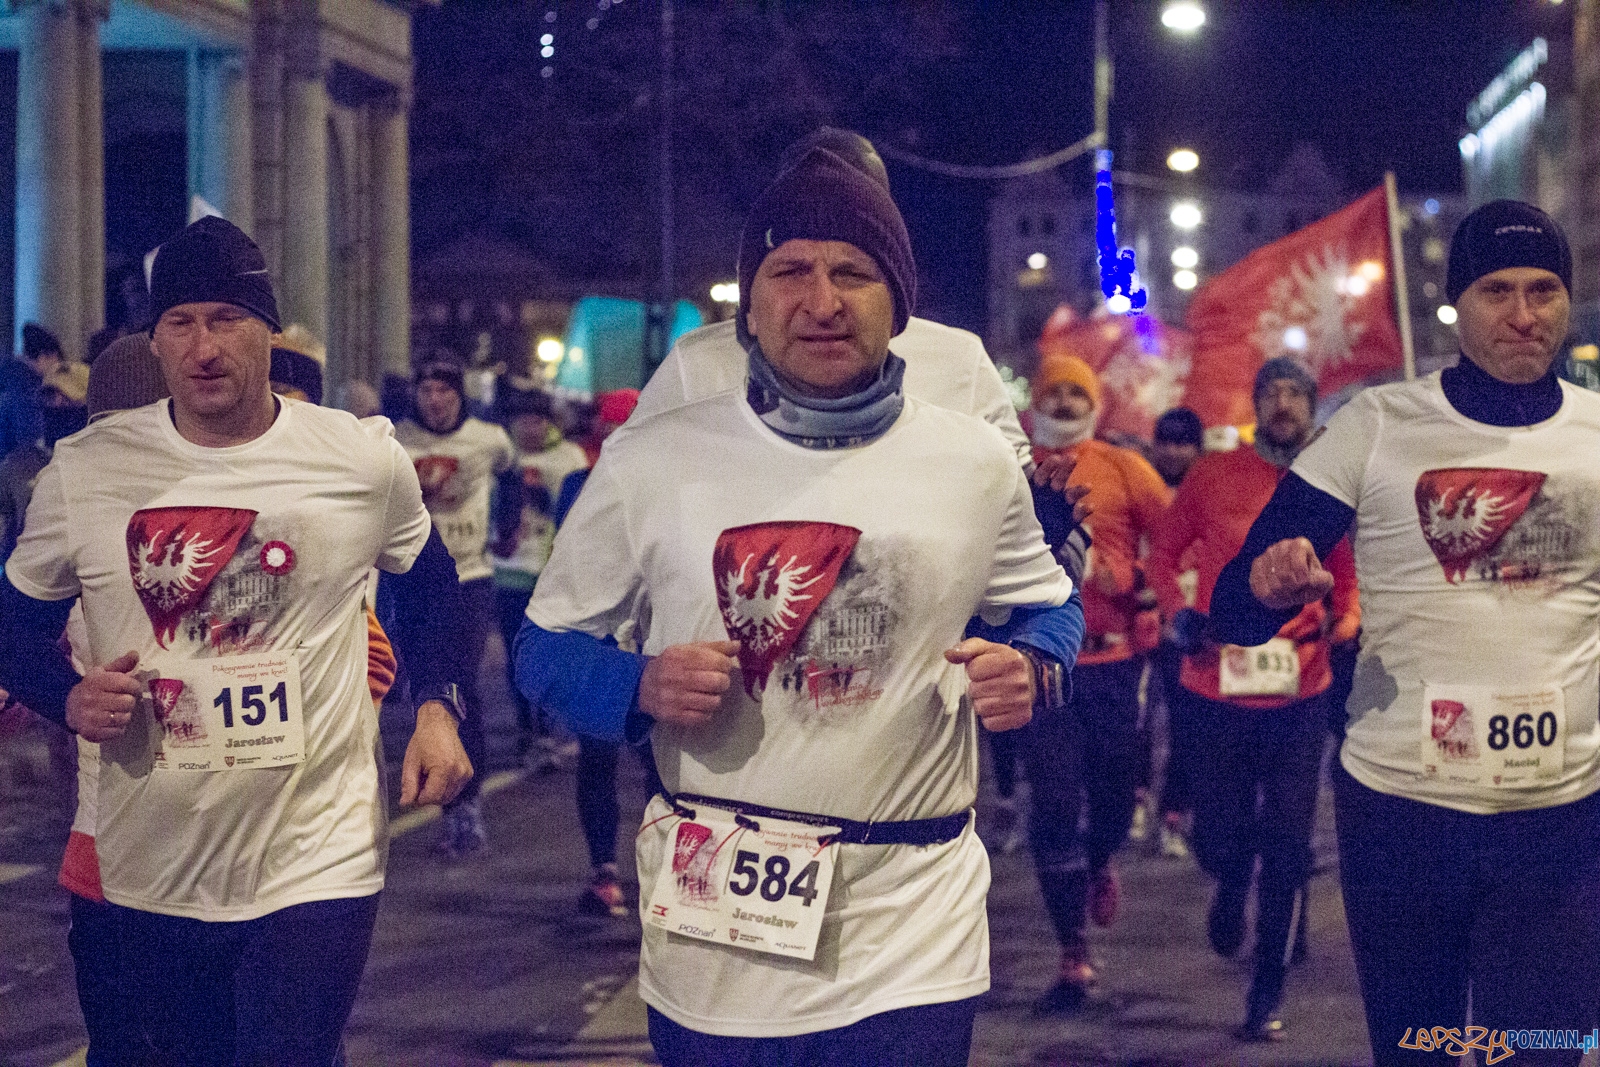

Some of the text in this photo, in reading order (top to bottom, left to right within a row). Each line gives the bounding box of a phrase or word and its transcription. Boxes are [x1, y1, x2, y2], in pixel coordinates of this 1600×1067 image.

[213, 681, 289, 728] 151
[224, 735, 286, 749] Jarosław
[1487, 711, 1558, 751] 860
[729, 849, 820, 908] 584
[732, 907, 798, 930] Jarosław
